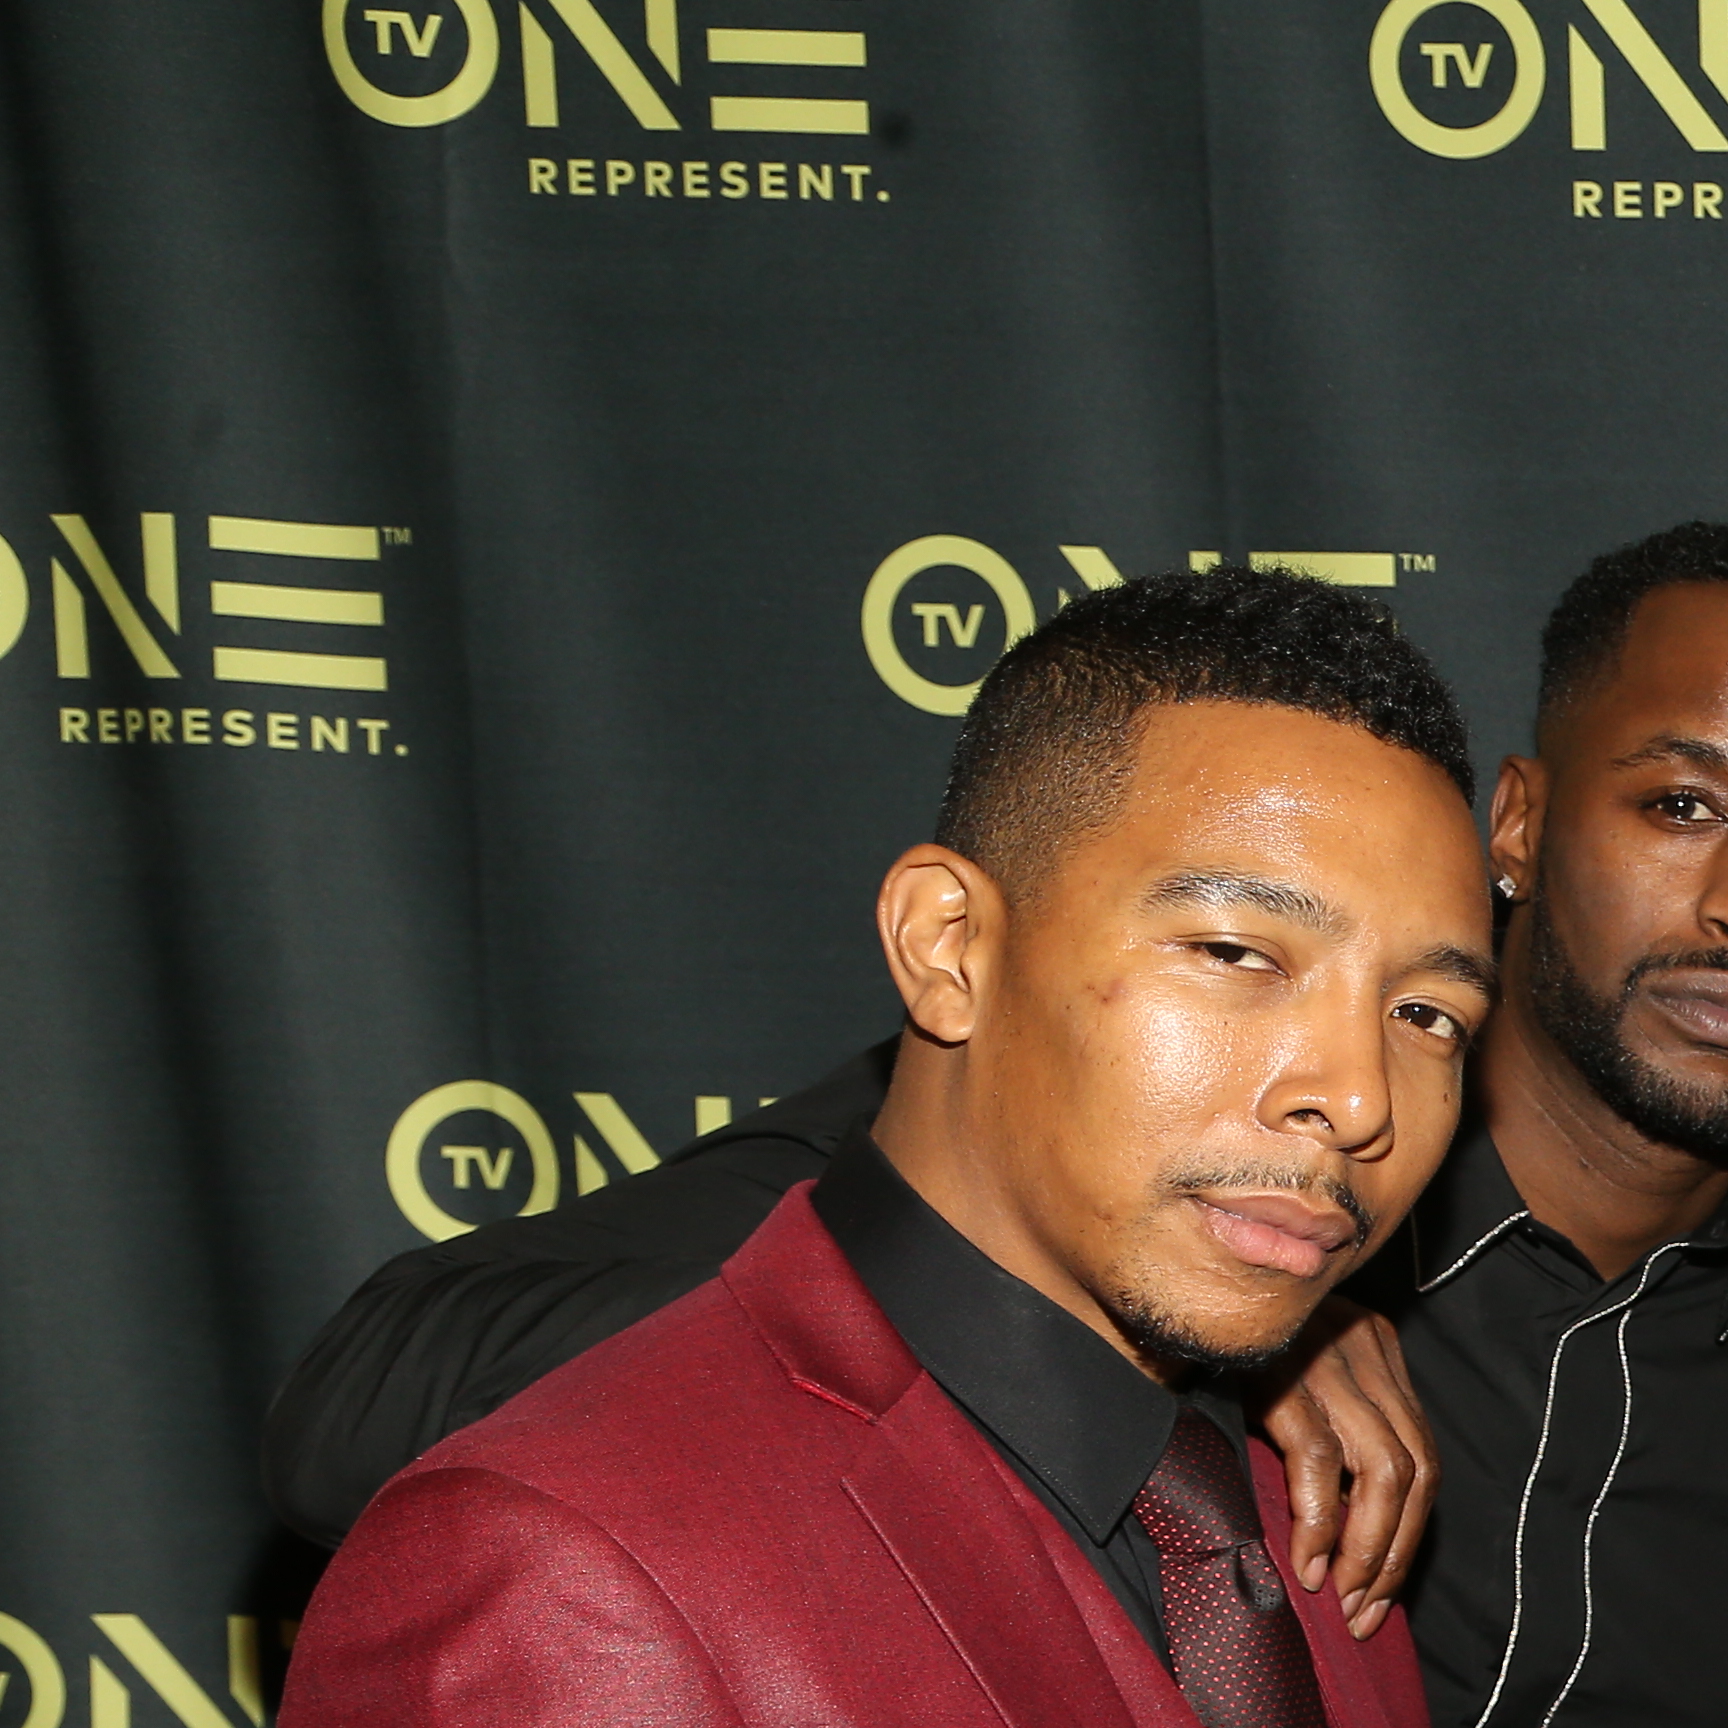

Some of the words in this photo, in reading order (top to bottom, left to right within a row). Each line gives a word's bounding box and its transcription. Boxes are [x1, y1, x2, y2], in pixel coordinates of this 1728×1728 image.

[364, 9, 443, 58] TV
[1420, 42, 1493, 89] TV
[527, 158, 891, 203] REPRESENT.
[0, 512, 388, 692] NE
[911, 603, 985, 648] TV
[60, 707, 408, 757] REPRESENT.
[440, 1145, 513, 1190] TV
